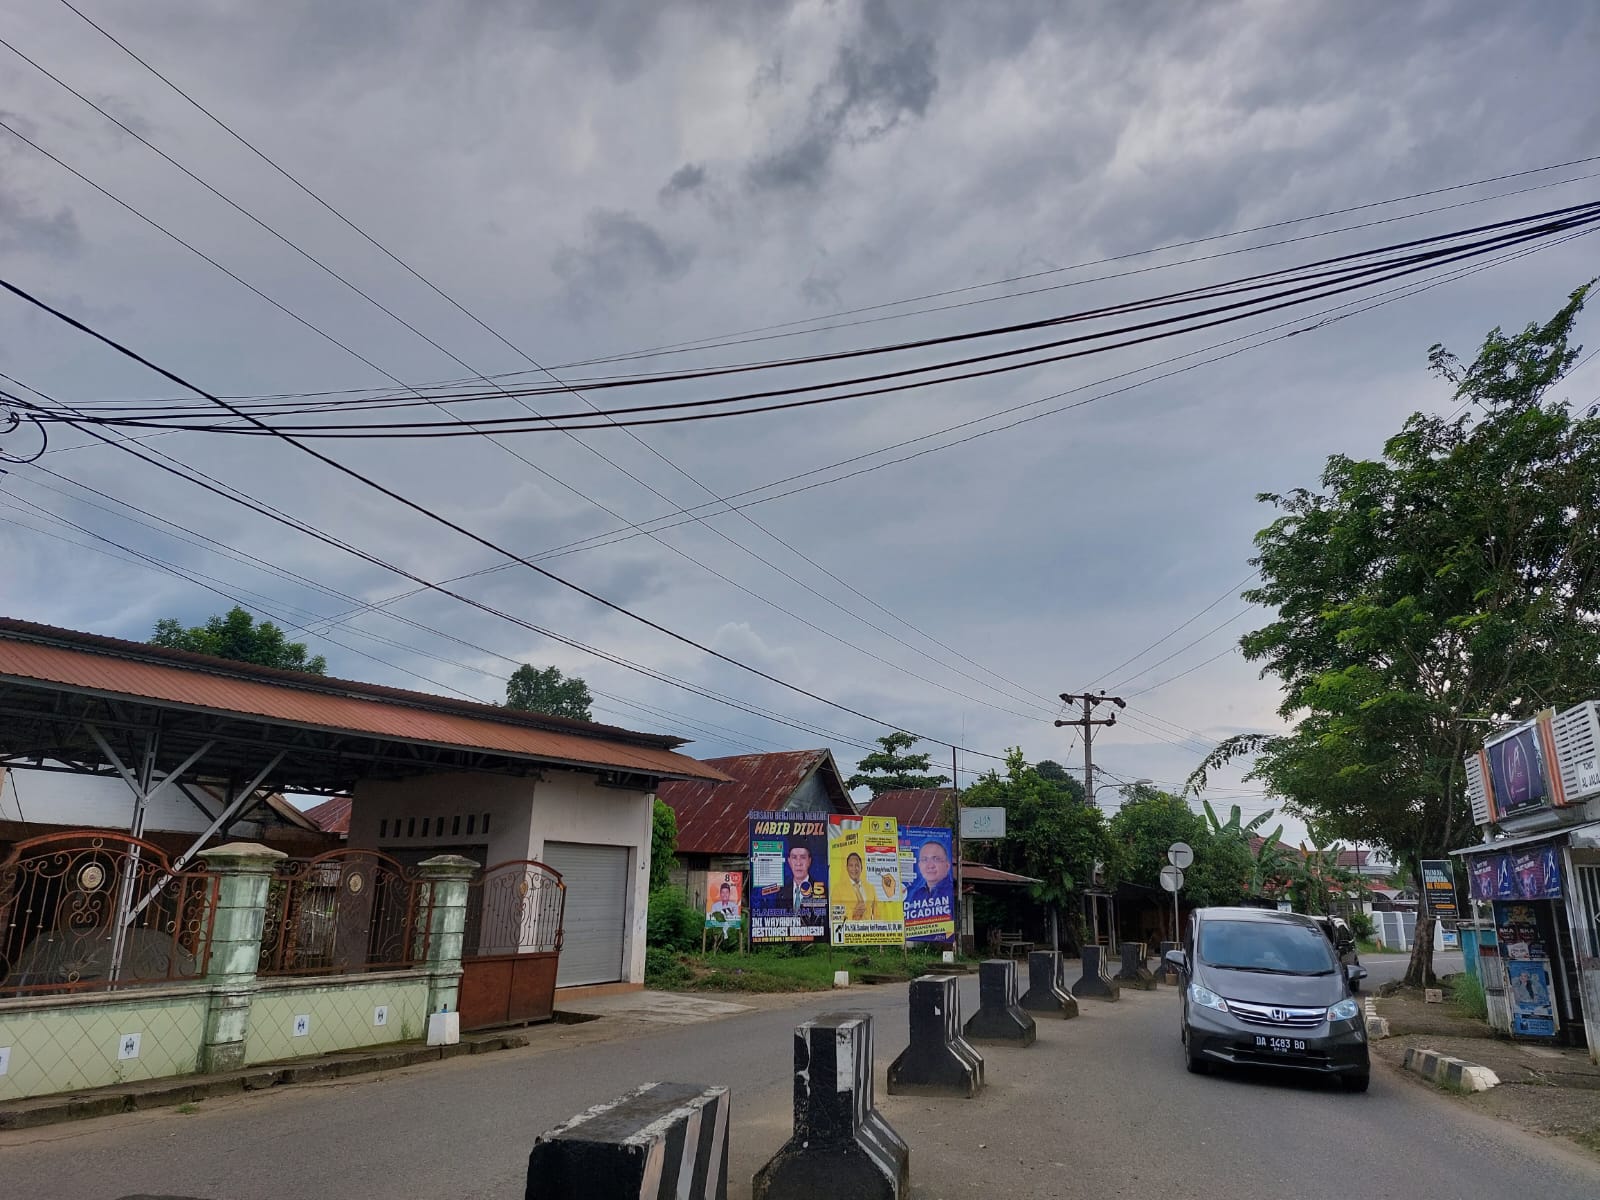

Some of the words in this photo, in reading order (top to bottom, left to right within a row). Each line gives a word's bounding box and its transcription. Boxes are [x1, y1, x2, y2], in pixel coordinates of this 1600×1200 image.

[754, 821, 790, 835] HABIB
[792, 822, 825, 835] DIDIL
[725, 873, 730, 882] 8
[813, 881, 825, 896] 5
[913, 896, 950, 909] HASAN
[752, 917, 763, 927] INI
[752, 926, 788, 938] RESTORASI
[789, 926, 825, 937] INDONESIA
[1256, 1036, 1267, 1047] DA
[1270, 1037, 1291, 1049] 1483
